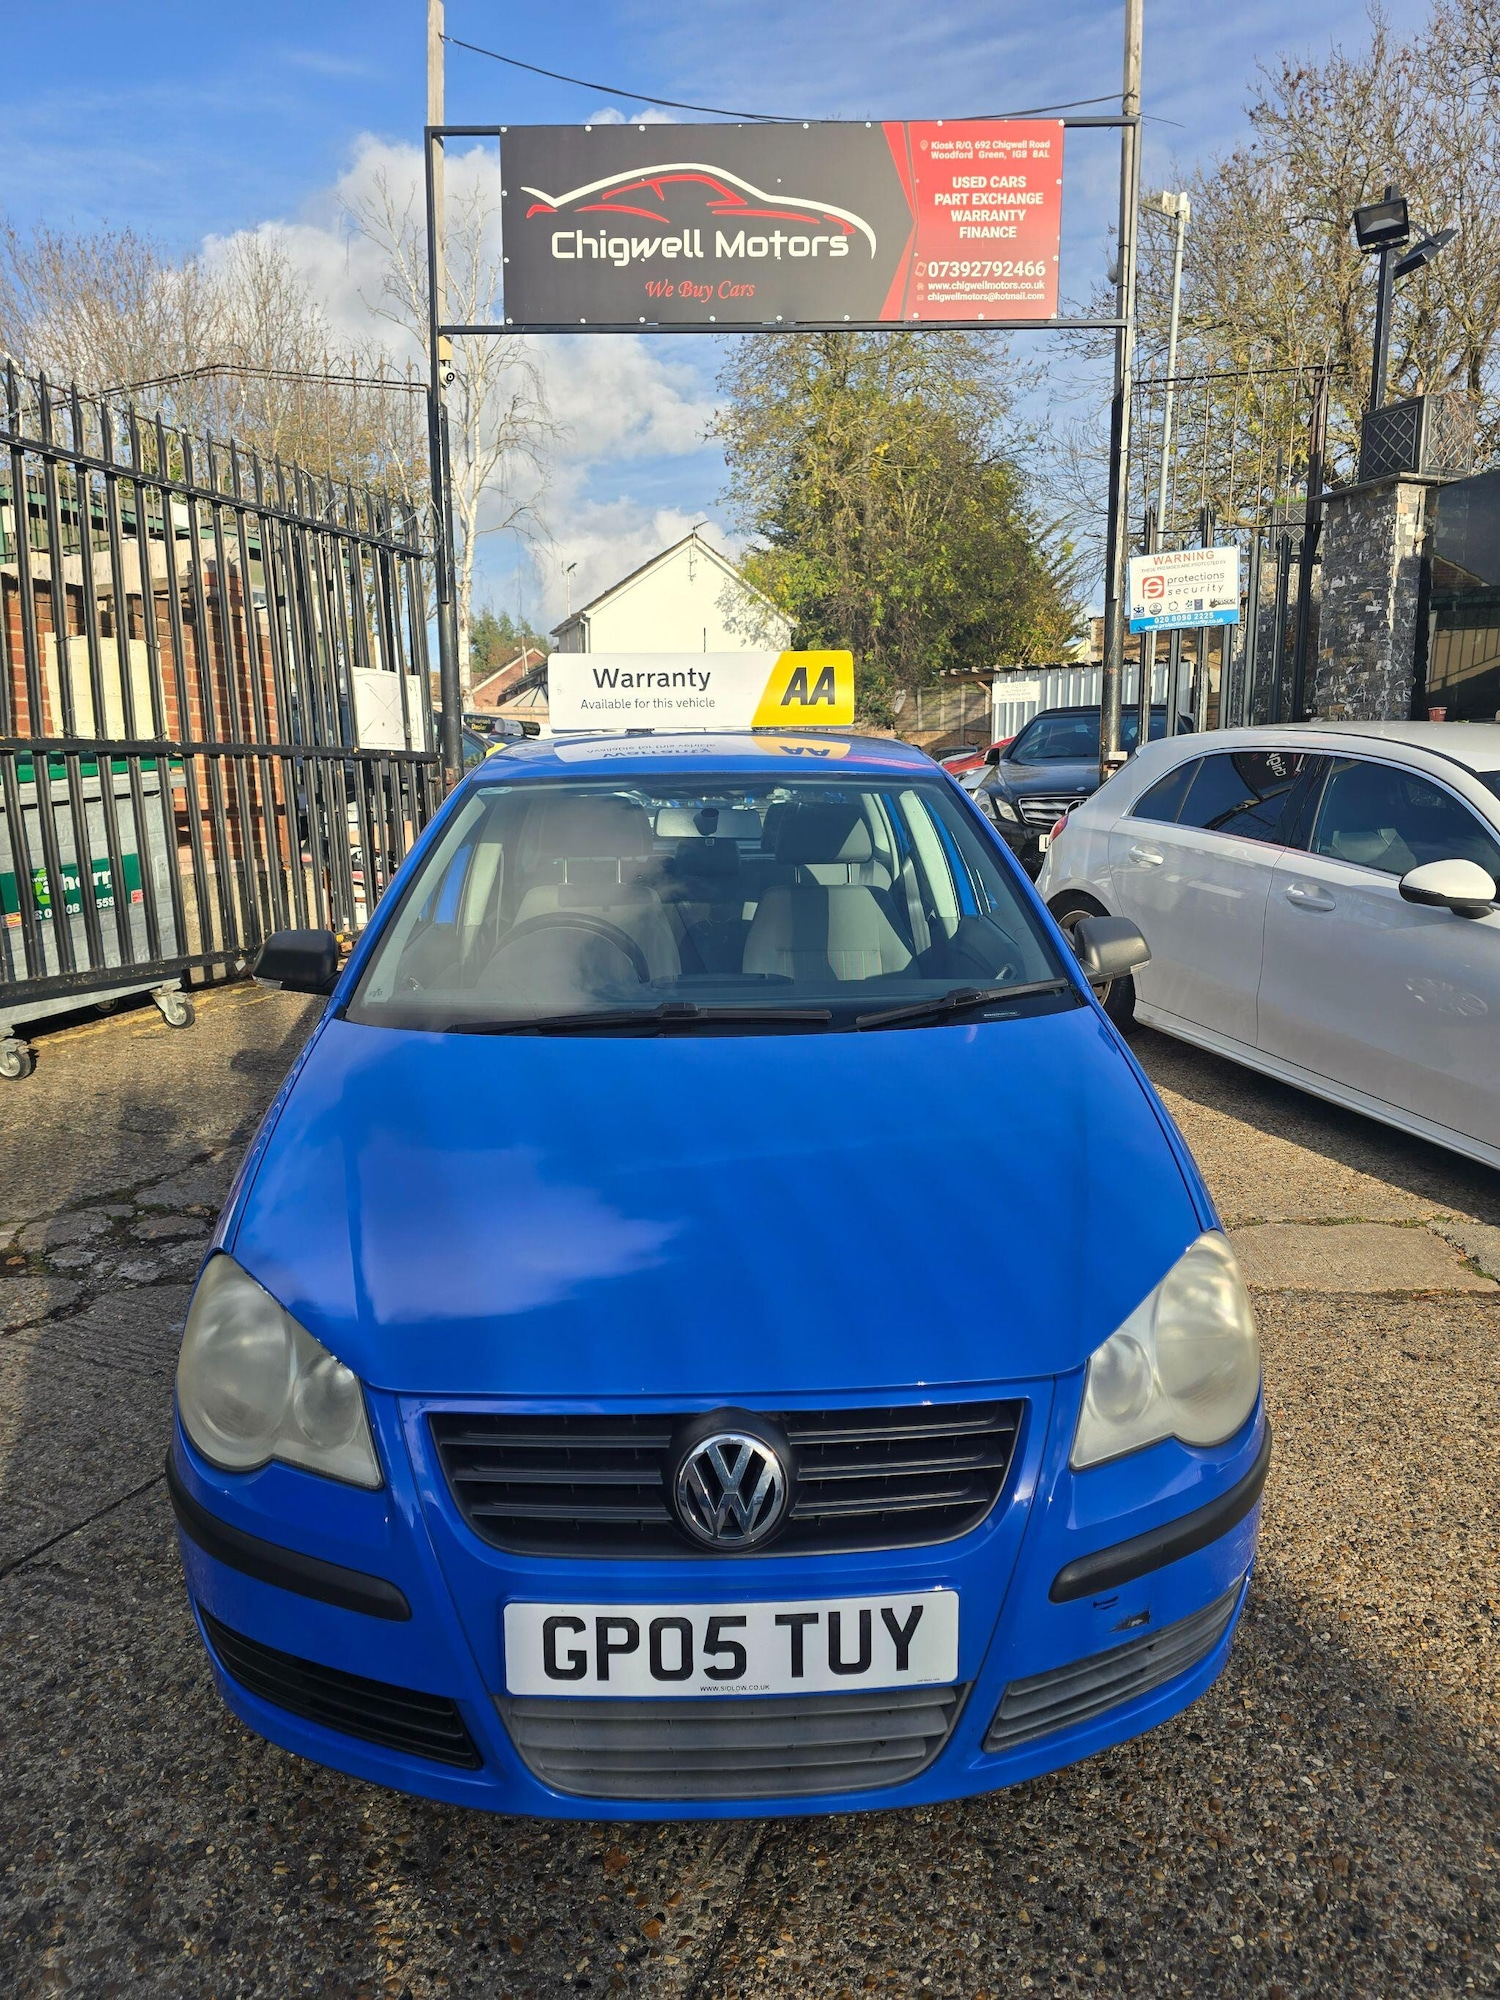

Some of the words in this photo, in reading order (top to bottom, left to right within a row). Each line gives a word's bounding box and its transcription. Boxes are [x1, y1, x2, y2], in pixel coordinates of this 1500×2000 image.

[931, 141, 954, 150] Kiosk
[974, 141, 991, 149] 692
[992, 140, 1027, 151] Chigwell
[1029, 140, 1051, 149] Road
[930, 150, 973, 159] Woodford
[978, 150, 1007, 160] Green,
[1012, 150, 1028, 158] IG8
[1032, 150, 1050, 158] 8AL
[952, 176, 987, 189] USED
[989, 176, 1027, 188] CARS
[934, 193, 970, 206] PART
[971, 192, 1044, 205] EXCHANGE
[950, 209, 1027, 222] WARRANTY
[959, 226, 1018, 239] FINANCE
[551, 229, 704, 267] Chigwell
[715, 229, 850, 259] Motors
[927, 261, 1046, 278] 07392792466
[645, 278, 675, 298] We
[678, 280, 714, 303] Buy
[717, 280, 756, 300] Cars
[927, 280, 1045, 291] www.chigwellmotors.co.uk
[927, 292, 1045, 303] chigwellmotors@hotmail.com
[1153, 550, 1215, 566] WARNING
[1167, 572, 1225, 586] protections
[1168, 584, 1224, 596] security
[1171, 614, 1192, 622] 8090
[1193, 612, 1214, 620] 2225
[592, 667, 711, 692] Warranty
[780, 666, 836, 706] AA
[580, 699, 632, 709] Available
[634, 698, 650, 709] for
[652, 697, 673, 709] this
[675, 697, 716, 708] vehicle
[542, 1614, 748, 1682] GP05
[774, 1604, 925, 1679] TUY
[699, 1684, 770, 1692] WWW.SIDLOW.CO.UK
